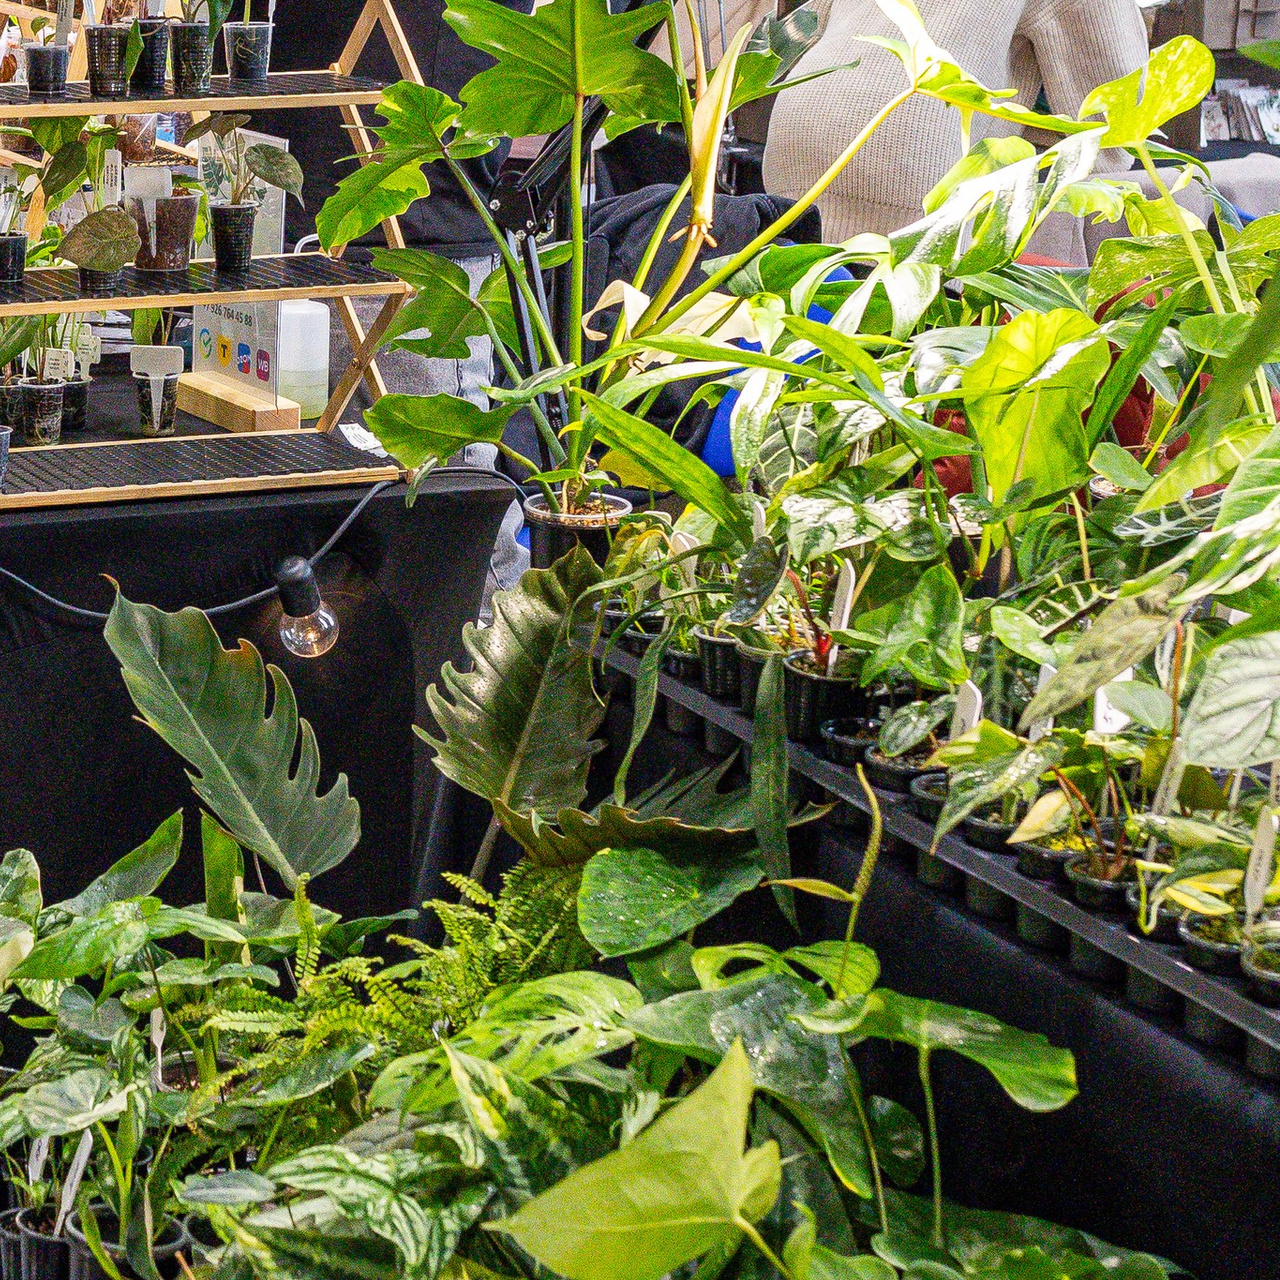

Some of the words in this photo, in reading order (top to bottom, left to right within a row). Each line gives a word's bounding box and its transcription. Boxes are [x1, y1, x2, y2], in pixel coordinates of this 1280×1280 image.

[211, 304, 223, 316] 926
[223, 307, 235, 320] 764
[235, 311, 244, 323] 45
[244, 314, 253, 327] 88
[258, 358, 269, 372] WB
